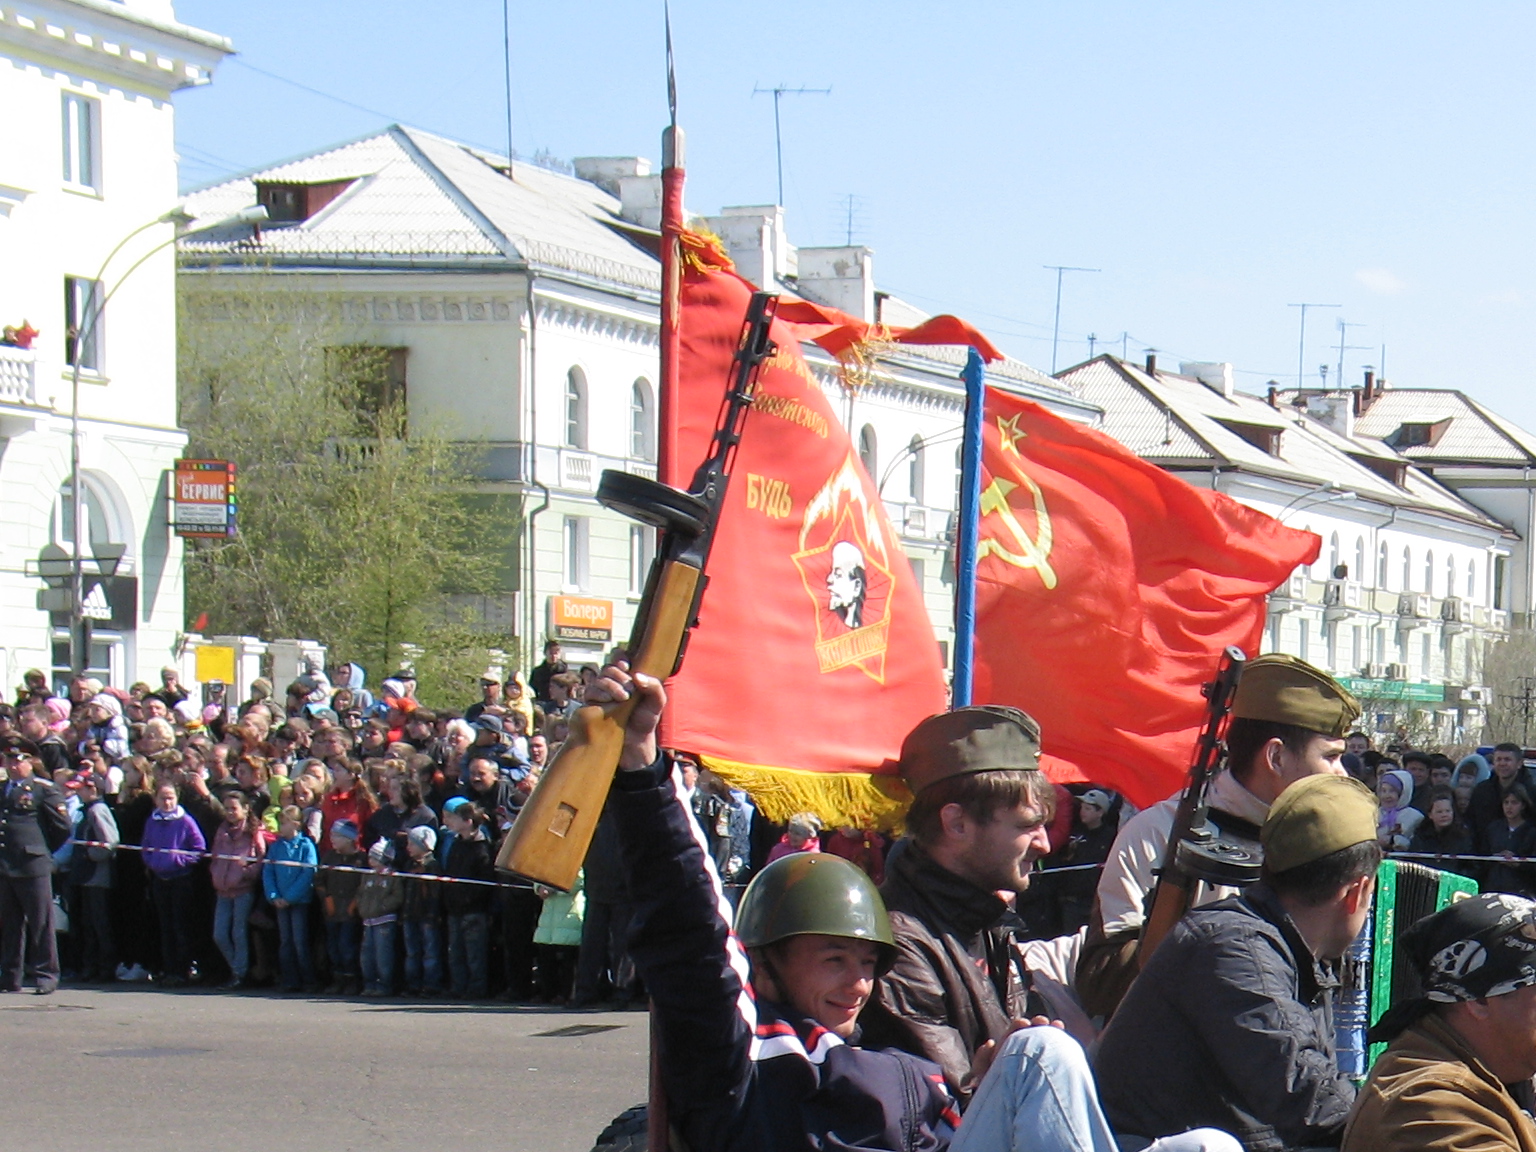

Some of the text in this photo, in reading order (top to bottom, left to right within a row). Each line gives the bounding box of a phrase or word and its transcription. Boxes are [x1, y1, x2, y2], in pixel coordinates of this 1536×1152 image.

[182, 483, 225, 500] СЕРВИС
[747, 472, 792, 519] БУДЬ
[563, 599, 608, 625] Болеро
